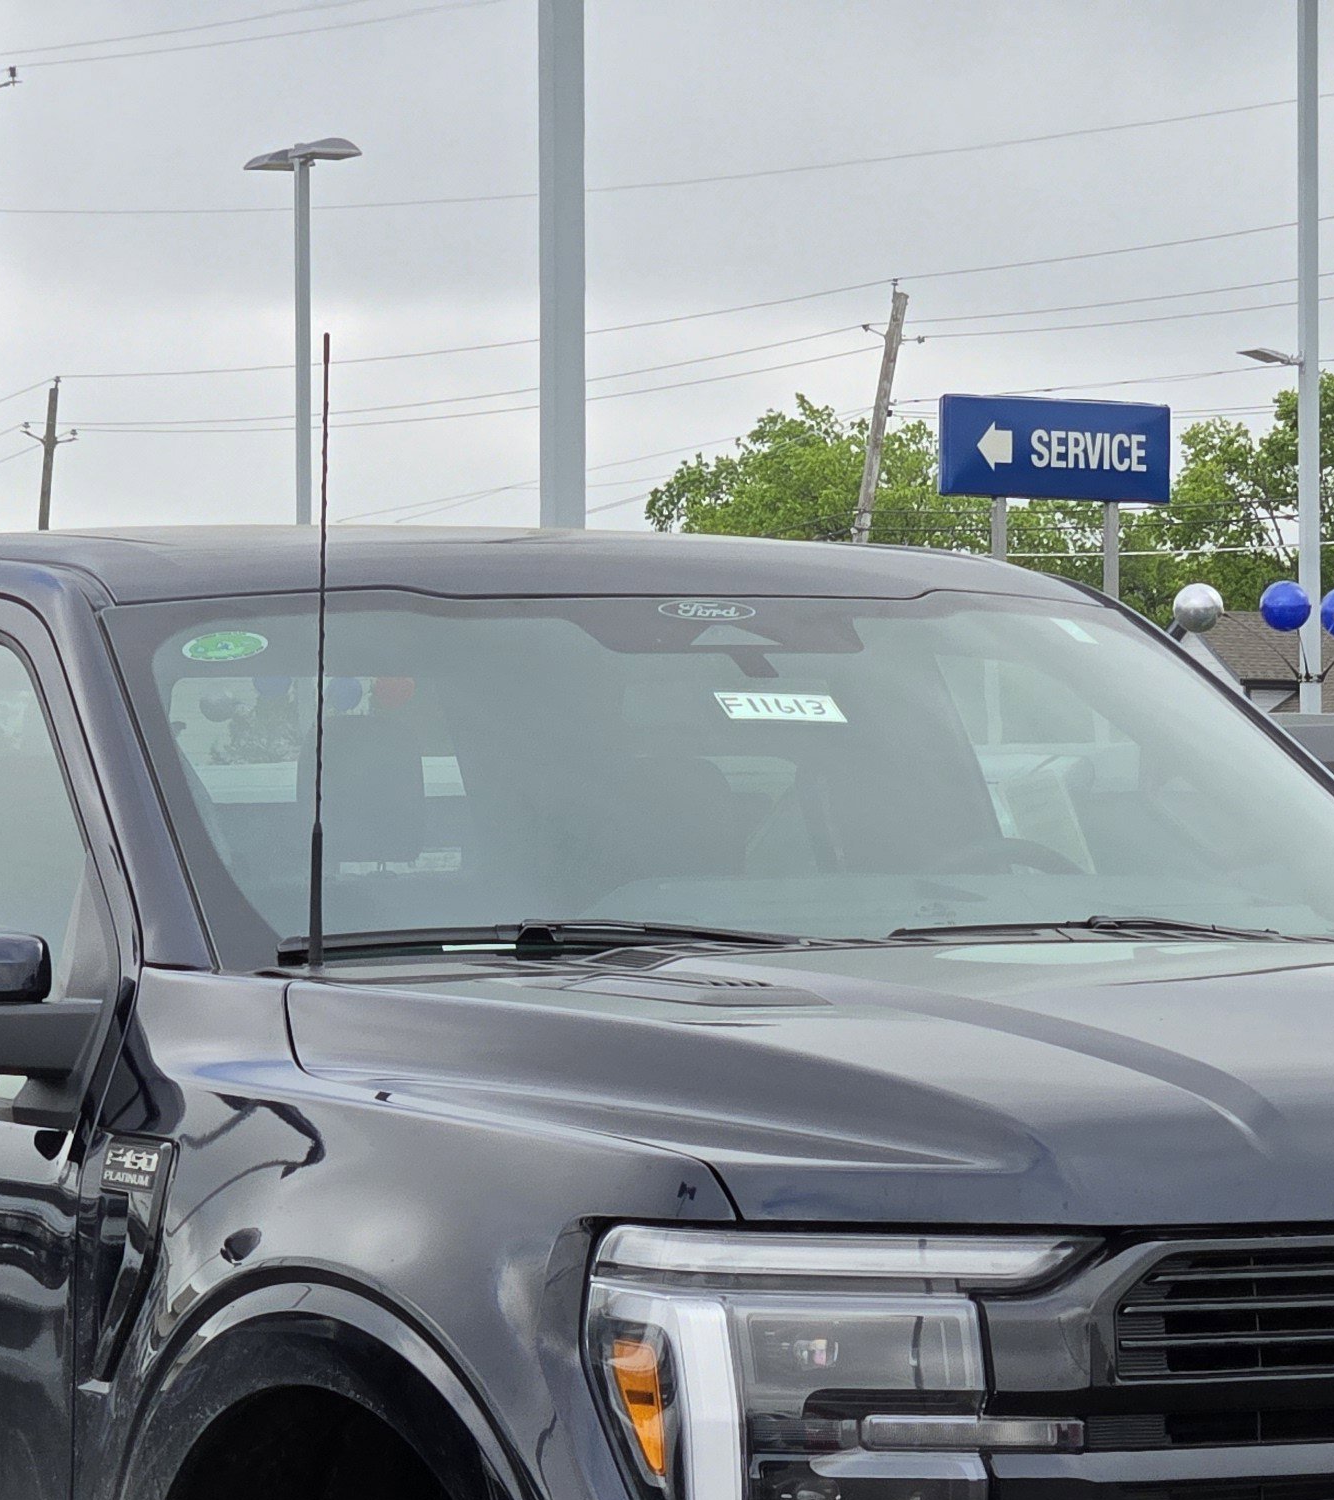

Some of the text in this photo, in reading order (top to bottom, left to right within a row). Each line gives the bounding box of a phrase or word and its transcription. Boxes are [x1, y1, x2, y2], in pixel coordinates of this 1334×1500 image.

[1031, 429, 1147, 472] SERVICE
[677, 602, 740, 618] Ford
[719, 696, 827, 716] F11613
[105, 1148, 159, 1172] F-150
[103, 1170, 150, 1187] PLATINUM
